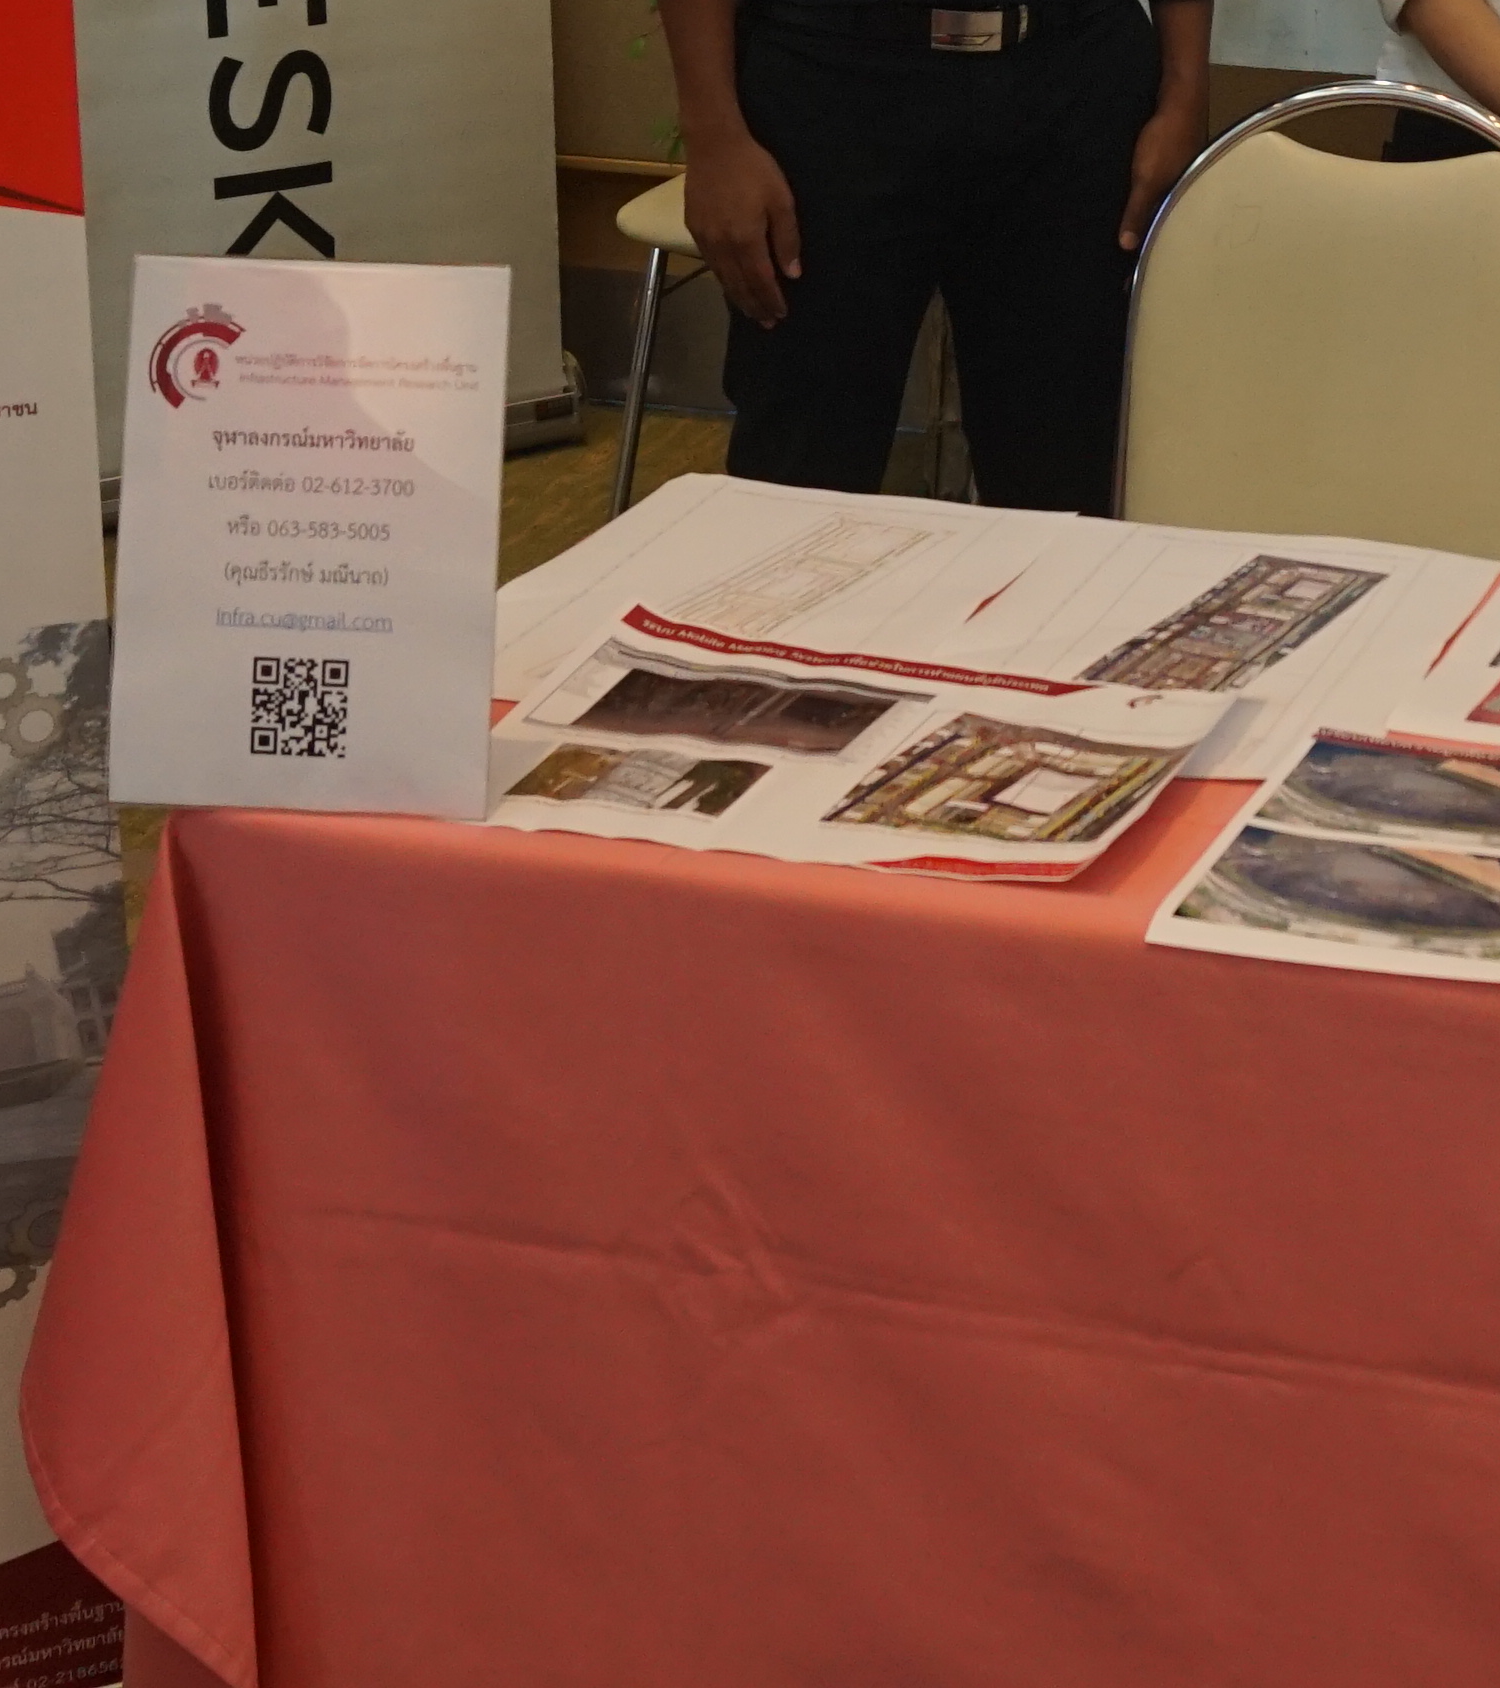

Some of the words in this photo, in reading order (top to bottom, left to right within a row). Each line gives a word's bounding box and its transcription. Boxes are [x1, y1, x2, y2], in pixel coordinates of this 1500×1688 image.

[212, 427, 415, 454] จุฬาลงกรณ์มหาวิทยาลัย
[208, 471, 296, 494] เบอร์ติดต่อ
[301, 478, 415, 499] 02-612-3700
[227, 514, 261, 537] หรือ
[267, 520, 391, 542] 063-583-5005
